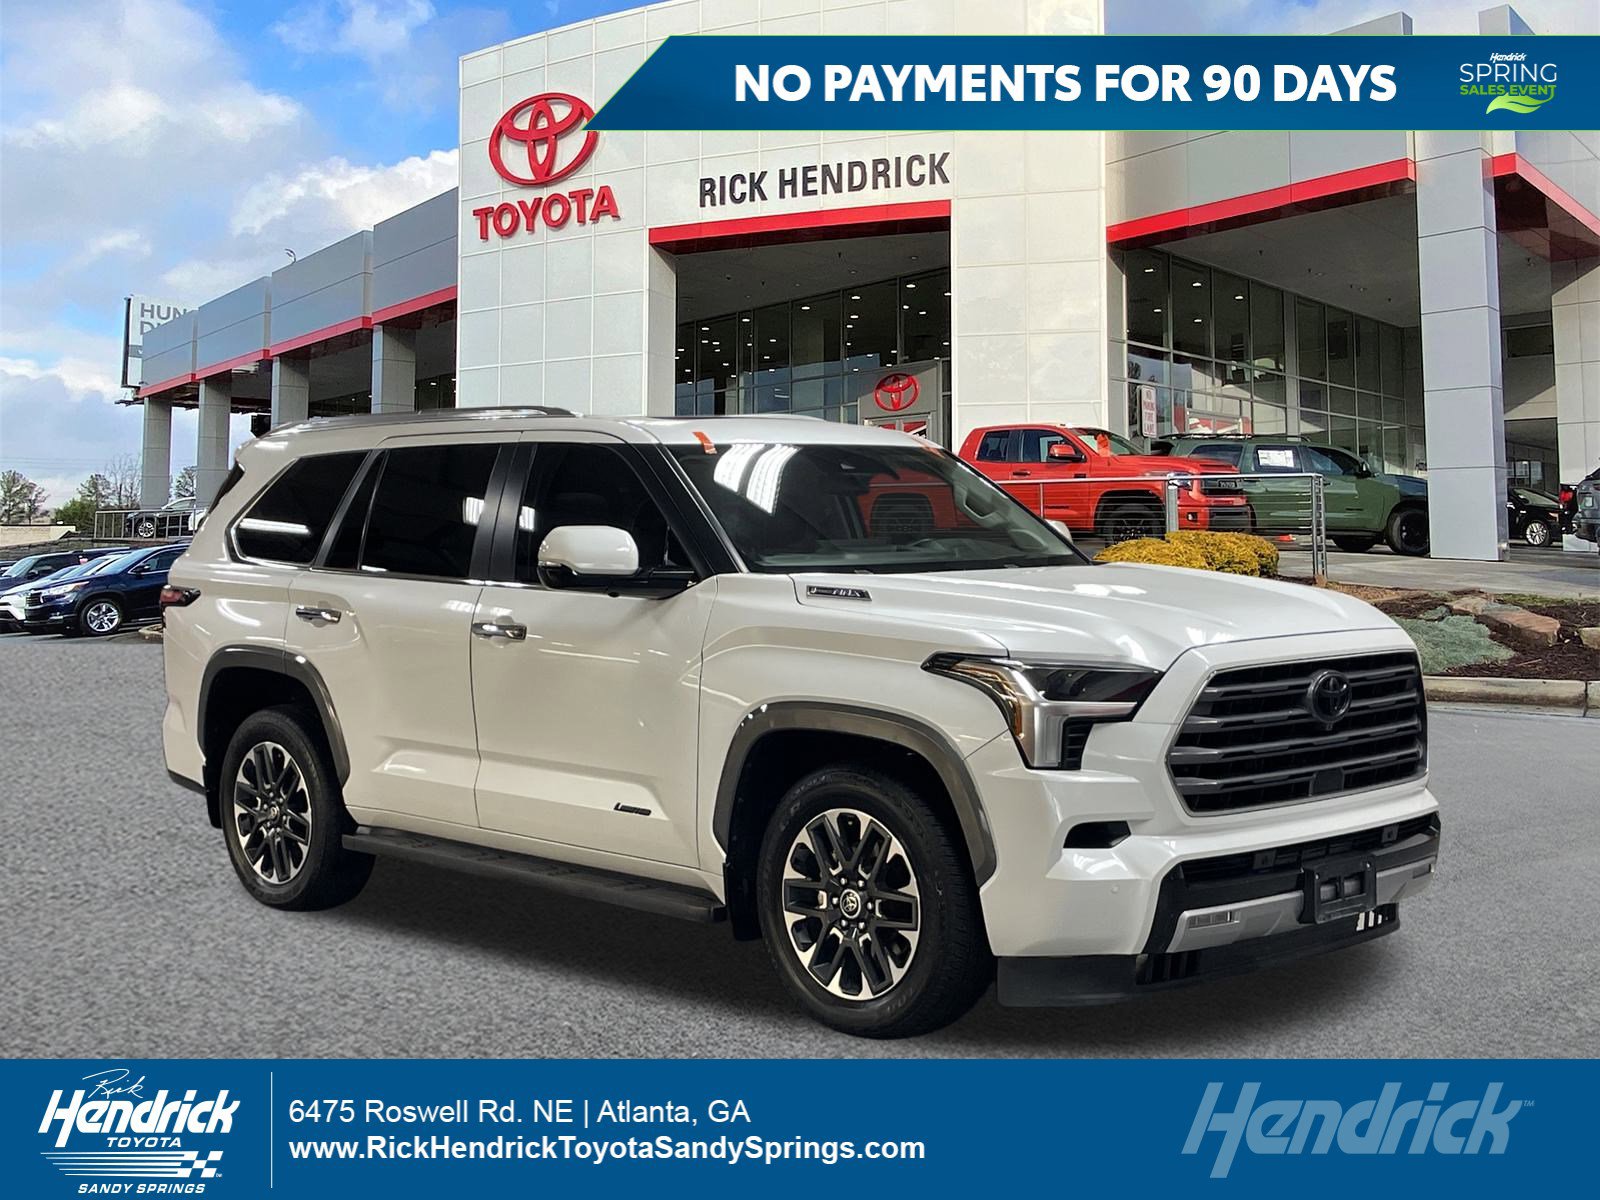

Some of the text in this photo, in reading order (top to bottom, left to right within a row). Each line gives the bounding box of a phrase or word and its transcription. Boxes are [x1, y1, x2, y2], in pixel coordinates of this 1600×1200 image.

[699, 152, 951, 208] RICK HENDRICK
[473, 185, 620, 241] TOYOTA
